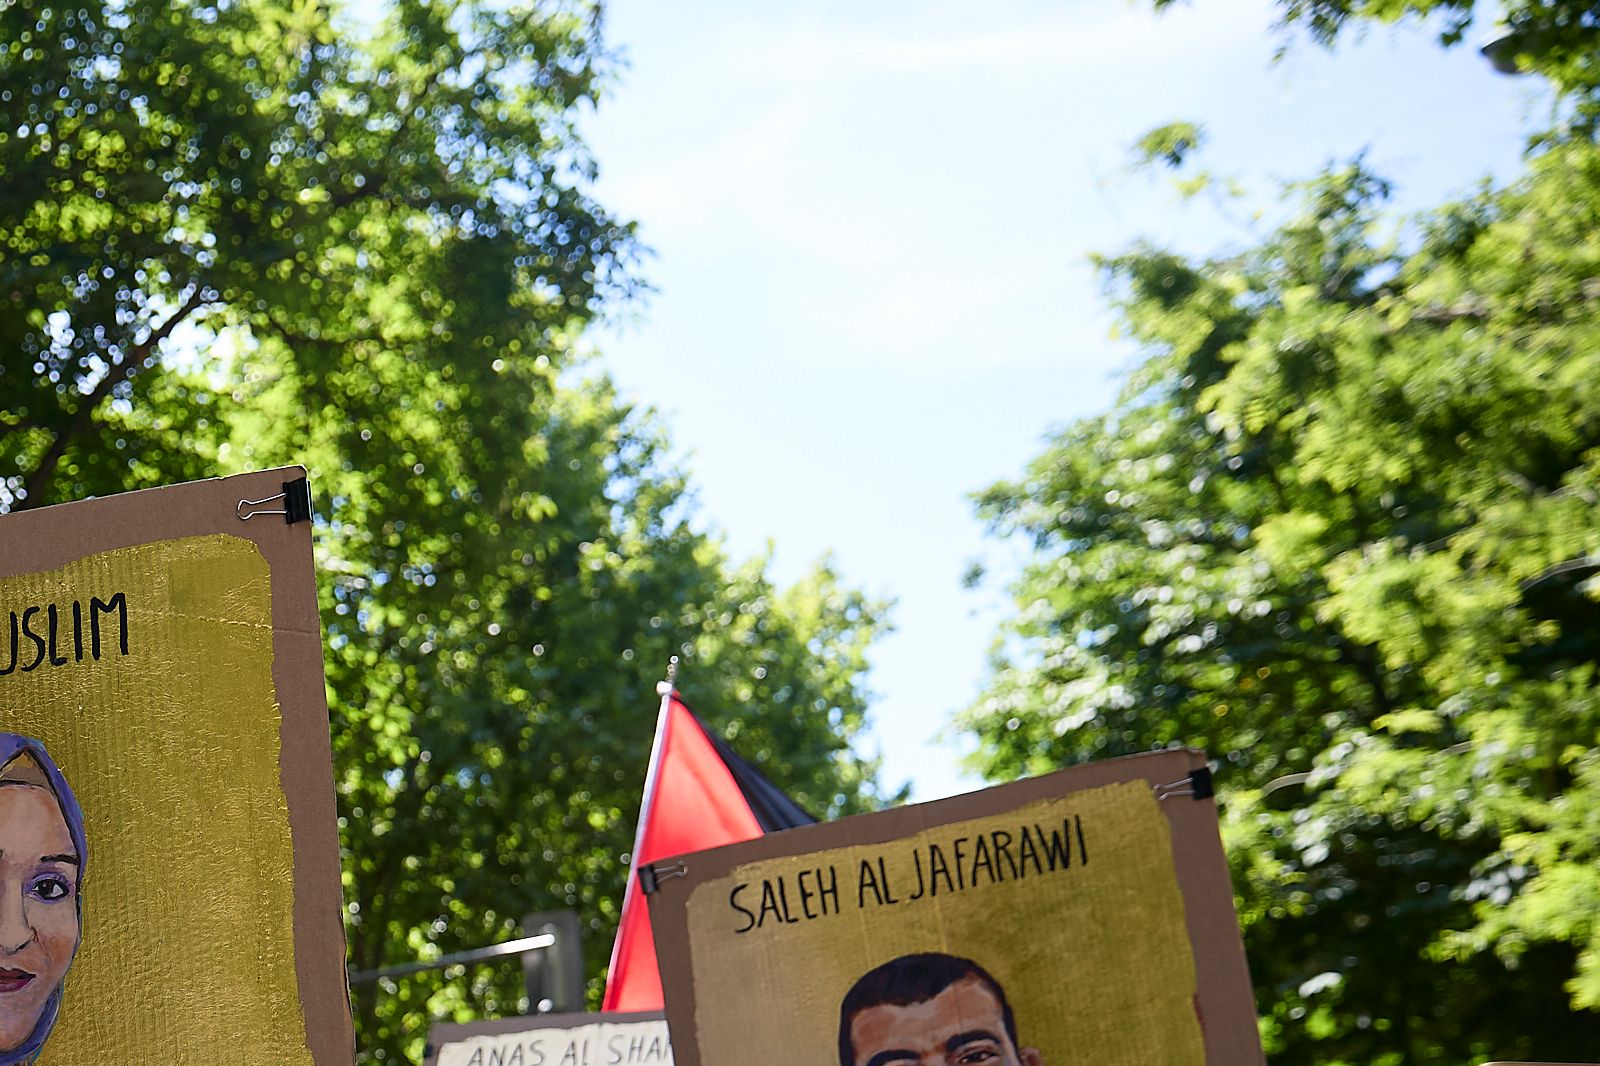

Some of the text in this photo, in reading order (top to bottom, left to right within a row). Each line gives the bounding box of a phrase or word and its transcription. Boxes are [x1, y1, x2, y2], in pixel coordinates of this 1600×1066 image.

[729, 813, 1089, 934] SALEH AL JAFARAWI
[559, 1037, 588, 1066] AL
